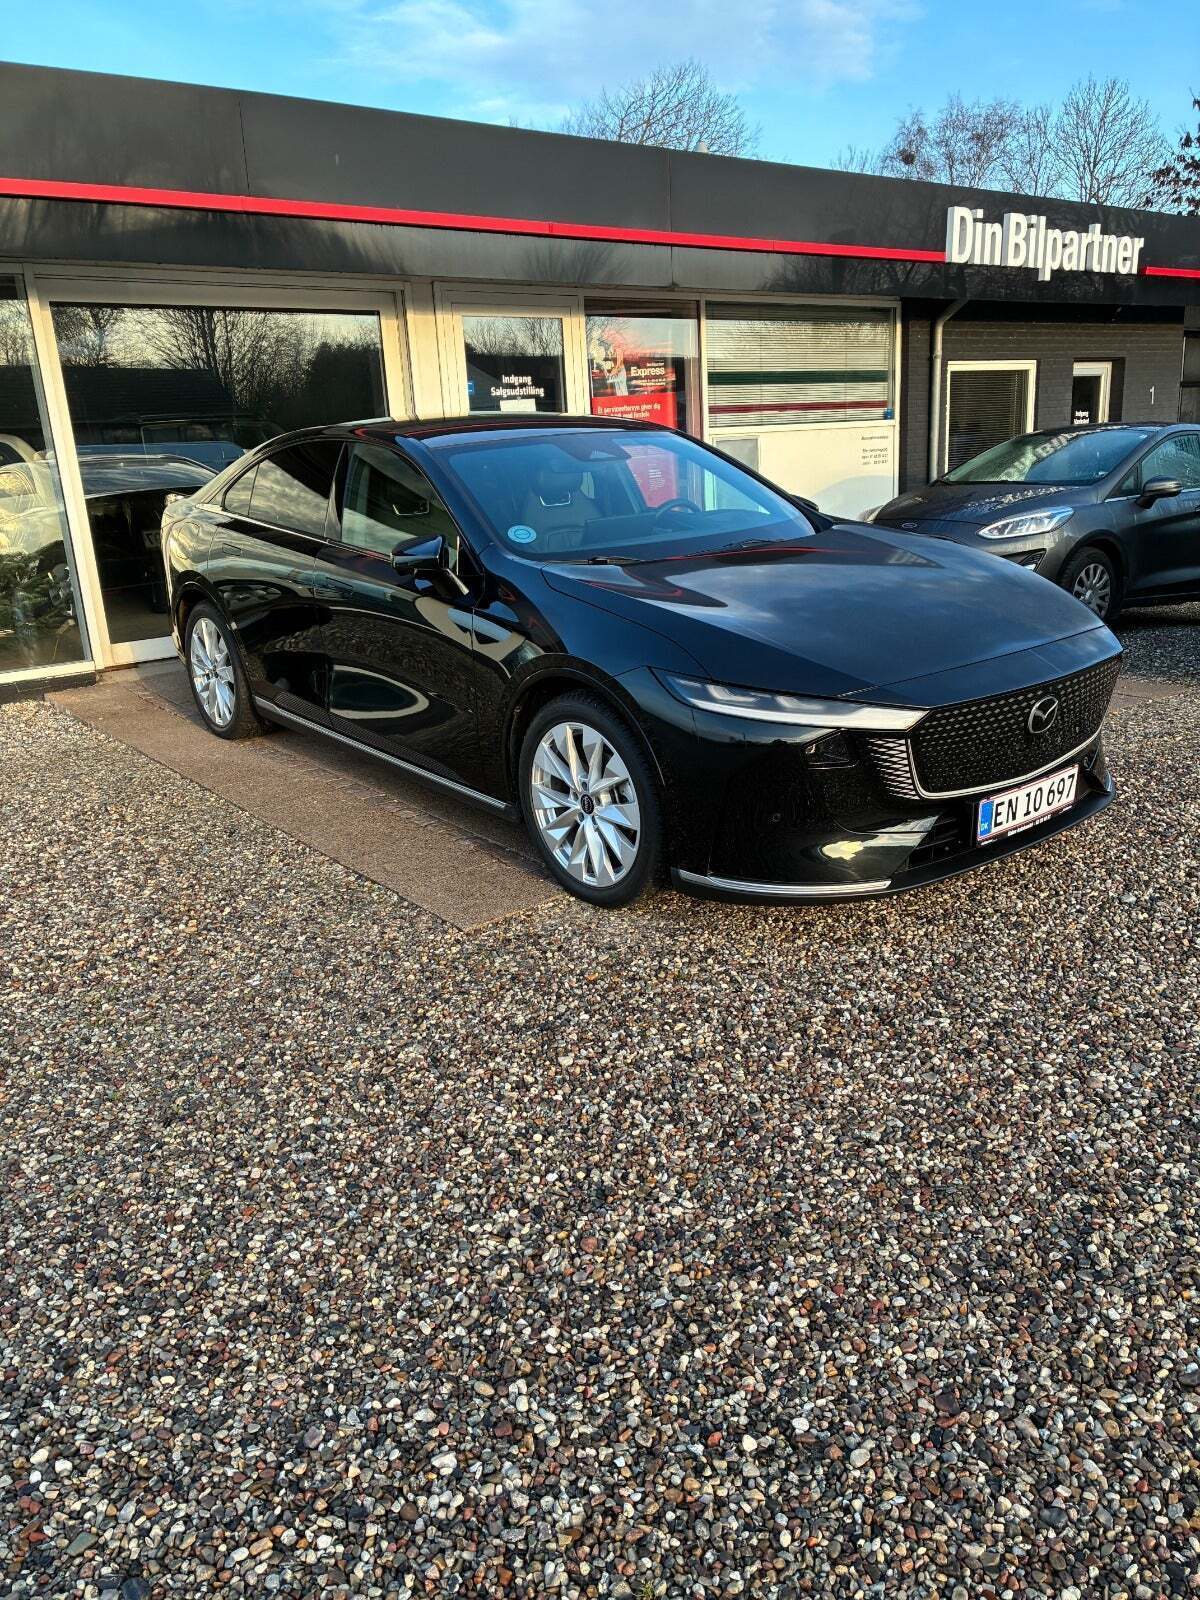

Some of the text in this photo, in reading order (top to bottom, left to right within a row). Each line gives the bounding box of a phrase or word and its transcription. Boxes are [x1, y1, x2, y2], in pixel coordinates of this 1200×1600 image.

[946, 206, 1144, 281] Din Bilpartner
[630, 366, 665, 378] Express
[502, 374, 532, 386] Indgang
[490, 386, 545, 398] Salgsudstilling
[1149, 386, 1155, 405] 1
[993, 797, 1019, 828] EN
[1023, 787, 1043, 817] 10
[1046, 773, 1076, 807] 697
